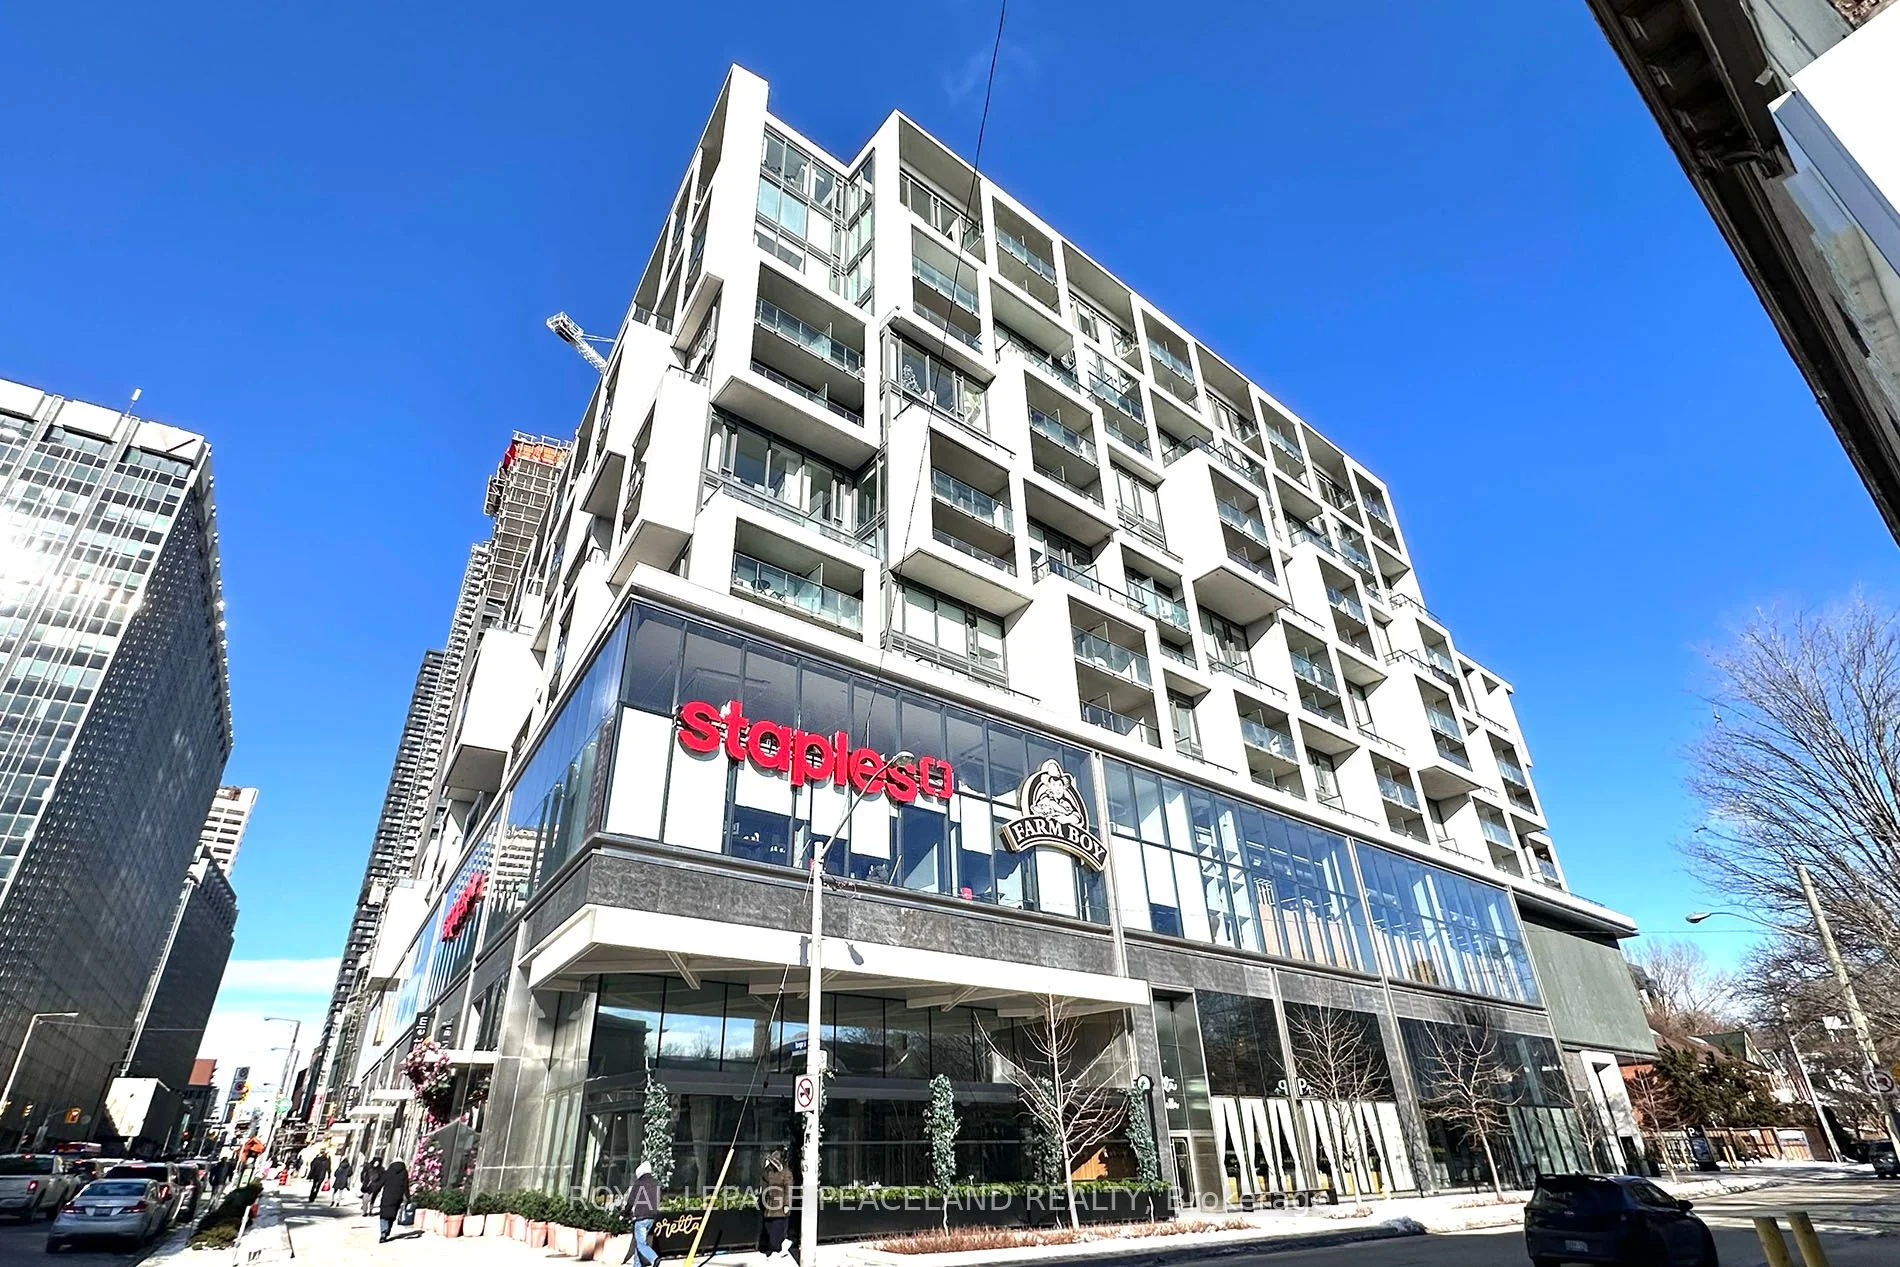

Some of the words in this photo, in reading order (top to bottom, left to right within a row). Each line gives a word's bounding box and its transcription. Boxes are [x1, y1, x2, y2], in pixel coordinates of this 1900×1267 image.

[677, 700, 918, 802] staples
[1011, 818, 1064, 842] FARM
[1067, 825, 1105, 859] BOY
